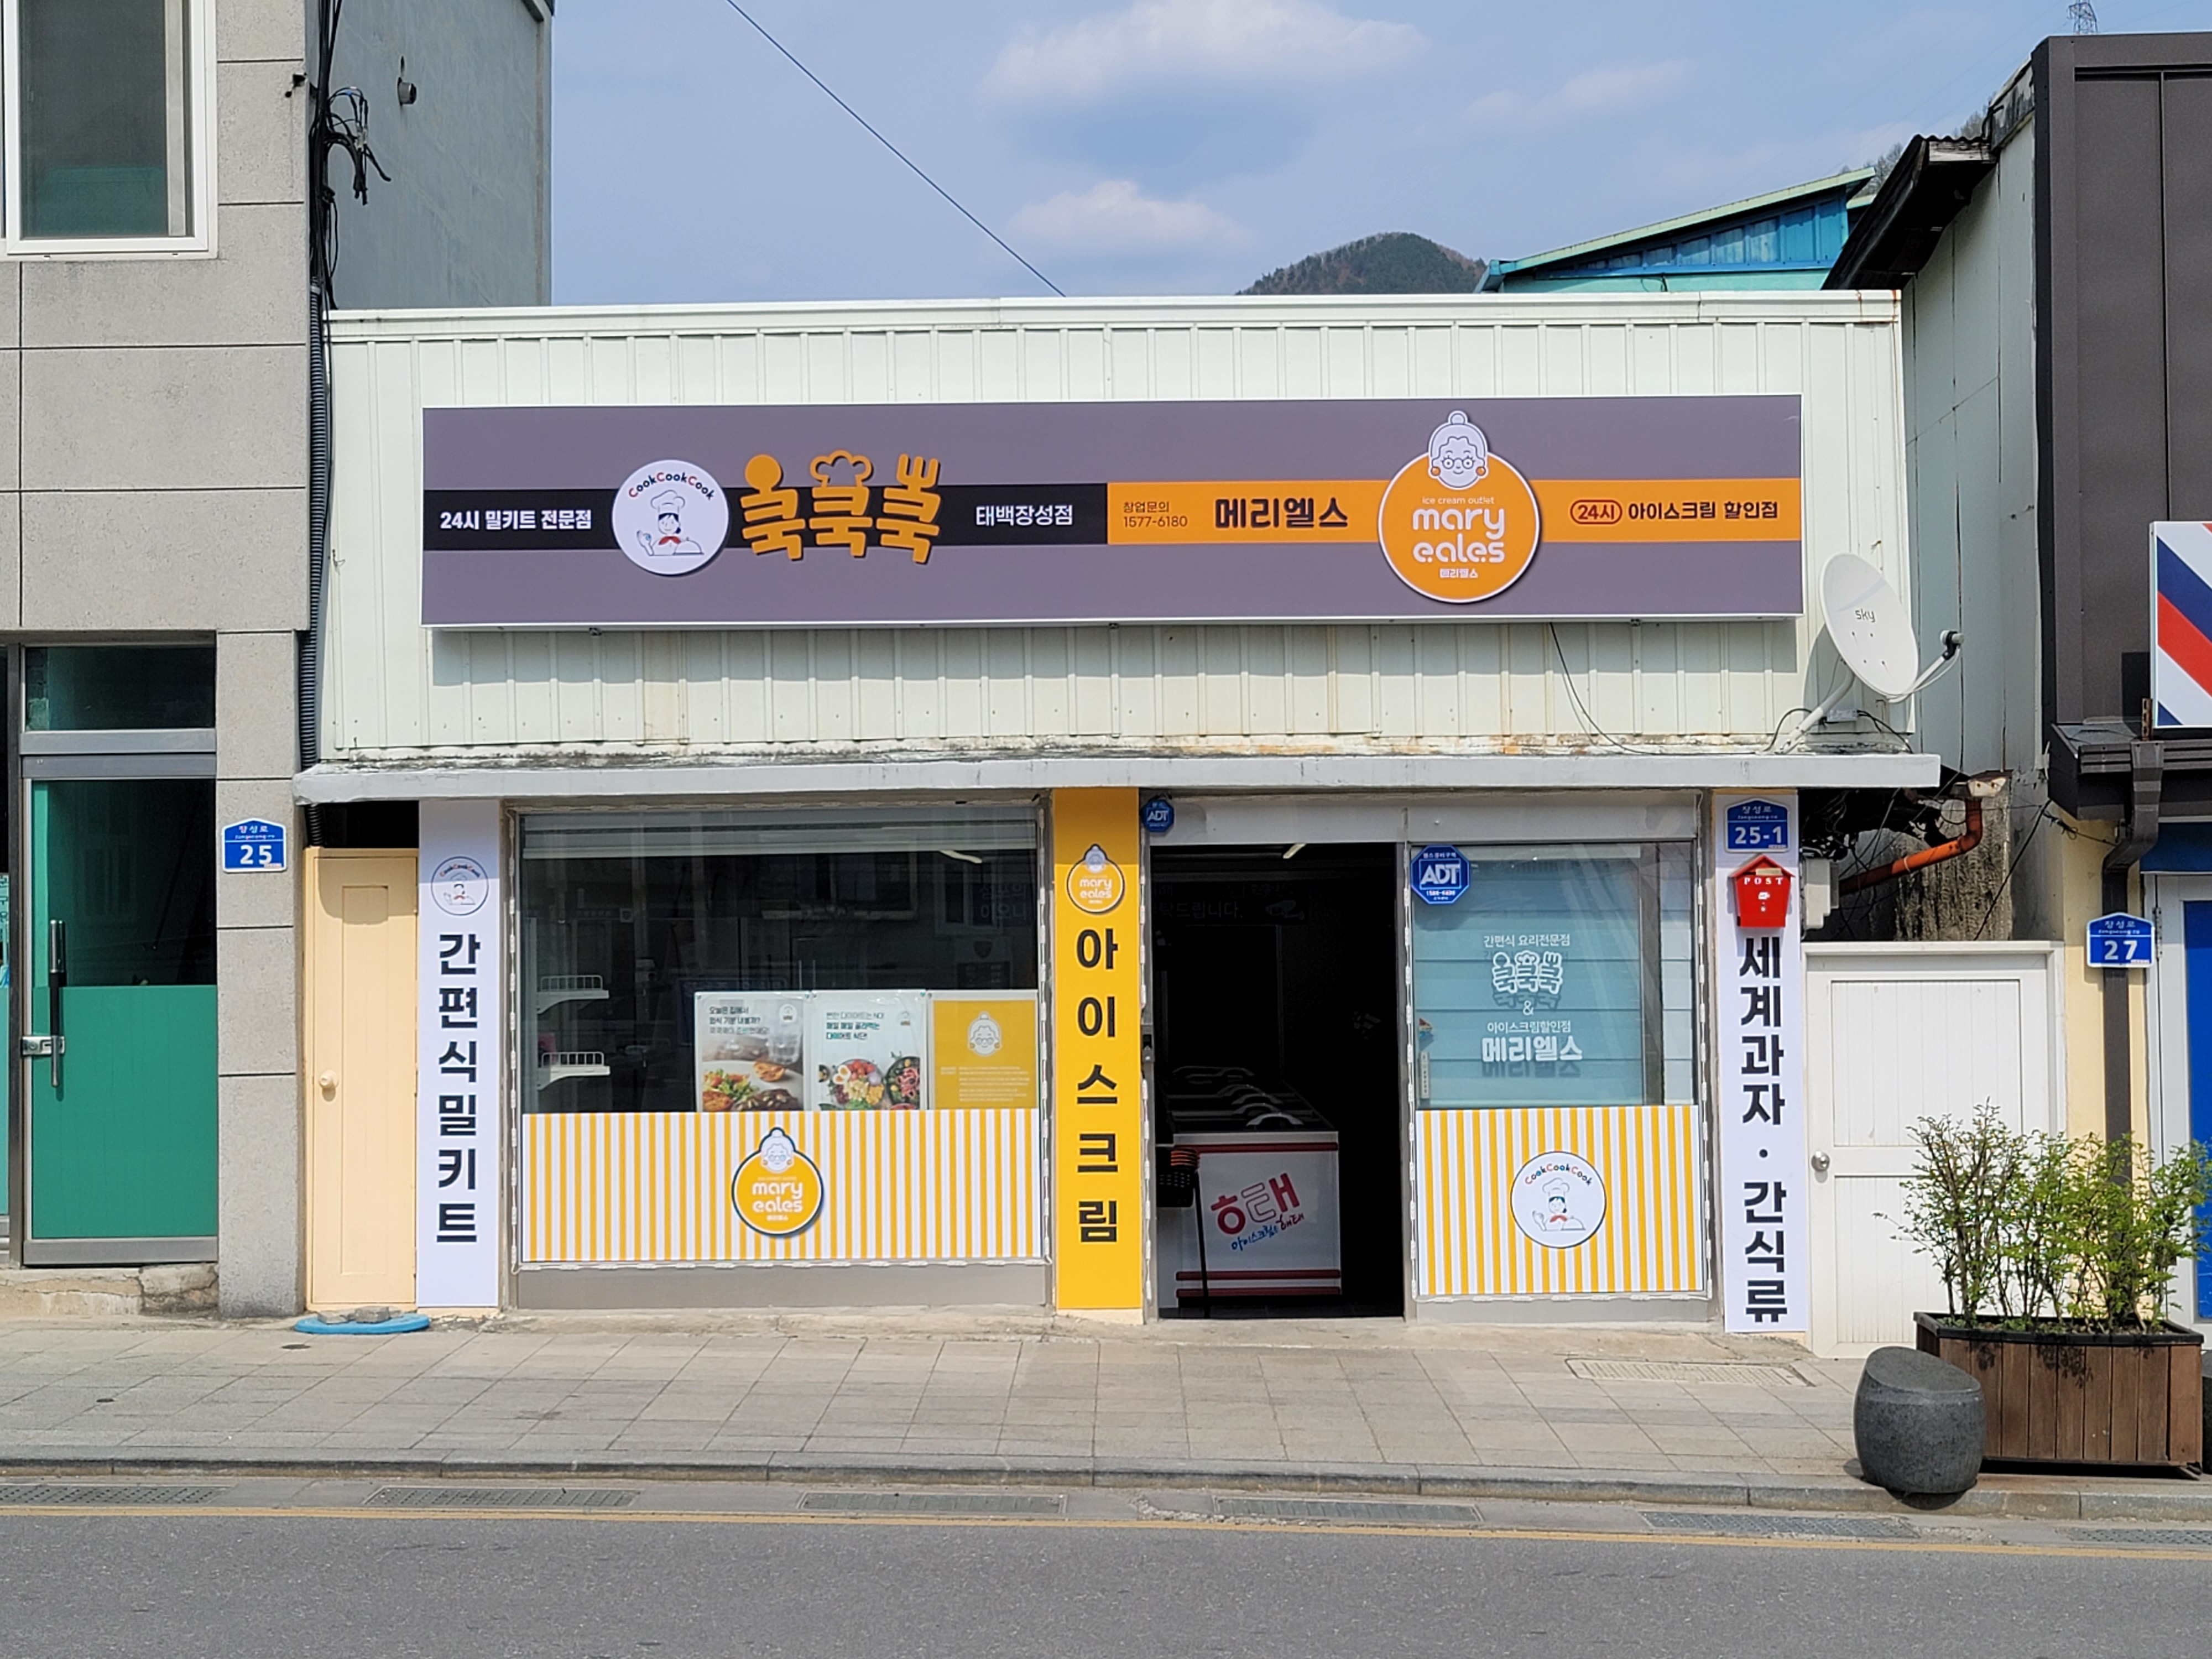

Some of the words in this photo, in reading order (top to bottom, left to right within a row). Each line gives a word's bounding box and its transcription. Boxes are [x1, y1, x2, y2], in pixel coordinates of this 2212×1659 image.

[628, 472, 715, 500] CookCookCook
[1123, 501, 1170, 513] 창업문의
[1422, 496, 1436, 505] ice
[1438, 497, 1466, 505] cream
[1468, 496, 1495, 505] outlet
[1577, 504, 1615, 521] 24시
[1627, 501, 1716, 521] 아이스크림
[1724, 500, 1778, 520] 할인점
[440, 510, 480, 530] 24시
[484, 510, 536, 530] 밀키트
[540, 509, 592, 530] 전문점
[975, 504, 1074, 527] 태백장성점
[1123, 515, 1188, 528] 1577-6180
[1214, 497, 1349, 529] 메리엘스
[1412, 508, 1505, 540] mary
[1412, 533, 1505, 563] eales
[1855, 608, 1876, 623] sky
[1147, 810, 1168, 822] ADT
[1734, 826, 1782, 845] 25-1
[239, 844, 273, 865] 25
[1420, 864, 1460, 884] ADT
[1744, 877, 1783, 885] POST
[1483, 935, 1515, 948] 간편식
[1517, 933, 1571, 946] 요리전문점
[2104, 939, 2138, 961] 27
[1522, 1000, 1534, 1016] &
[1486, 1020, 1571, 1034] 아이스크림할인점
[1481, 1035, 1583, 1062] 메리엘스
[436, 933, 481, 1243] 간편식밀키트
[1076, 927, 1119, 1243] 아이스크림
[1524, 1163, 1593, 1186] CookCookCook
[751, 1181, 804, 1200] mary
[752, 1196, 804, 1213] eales
